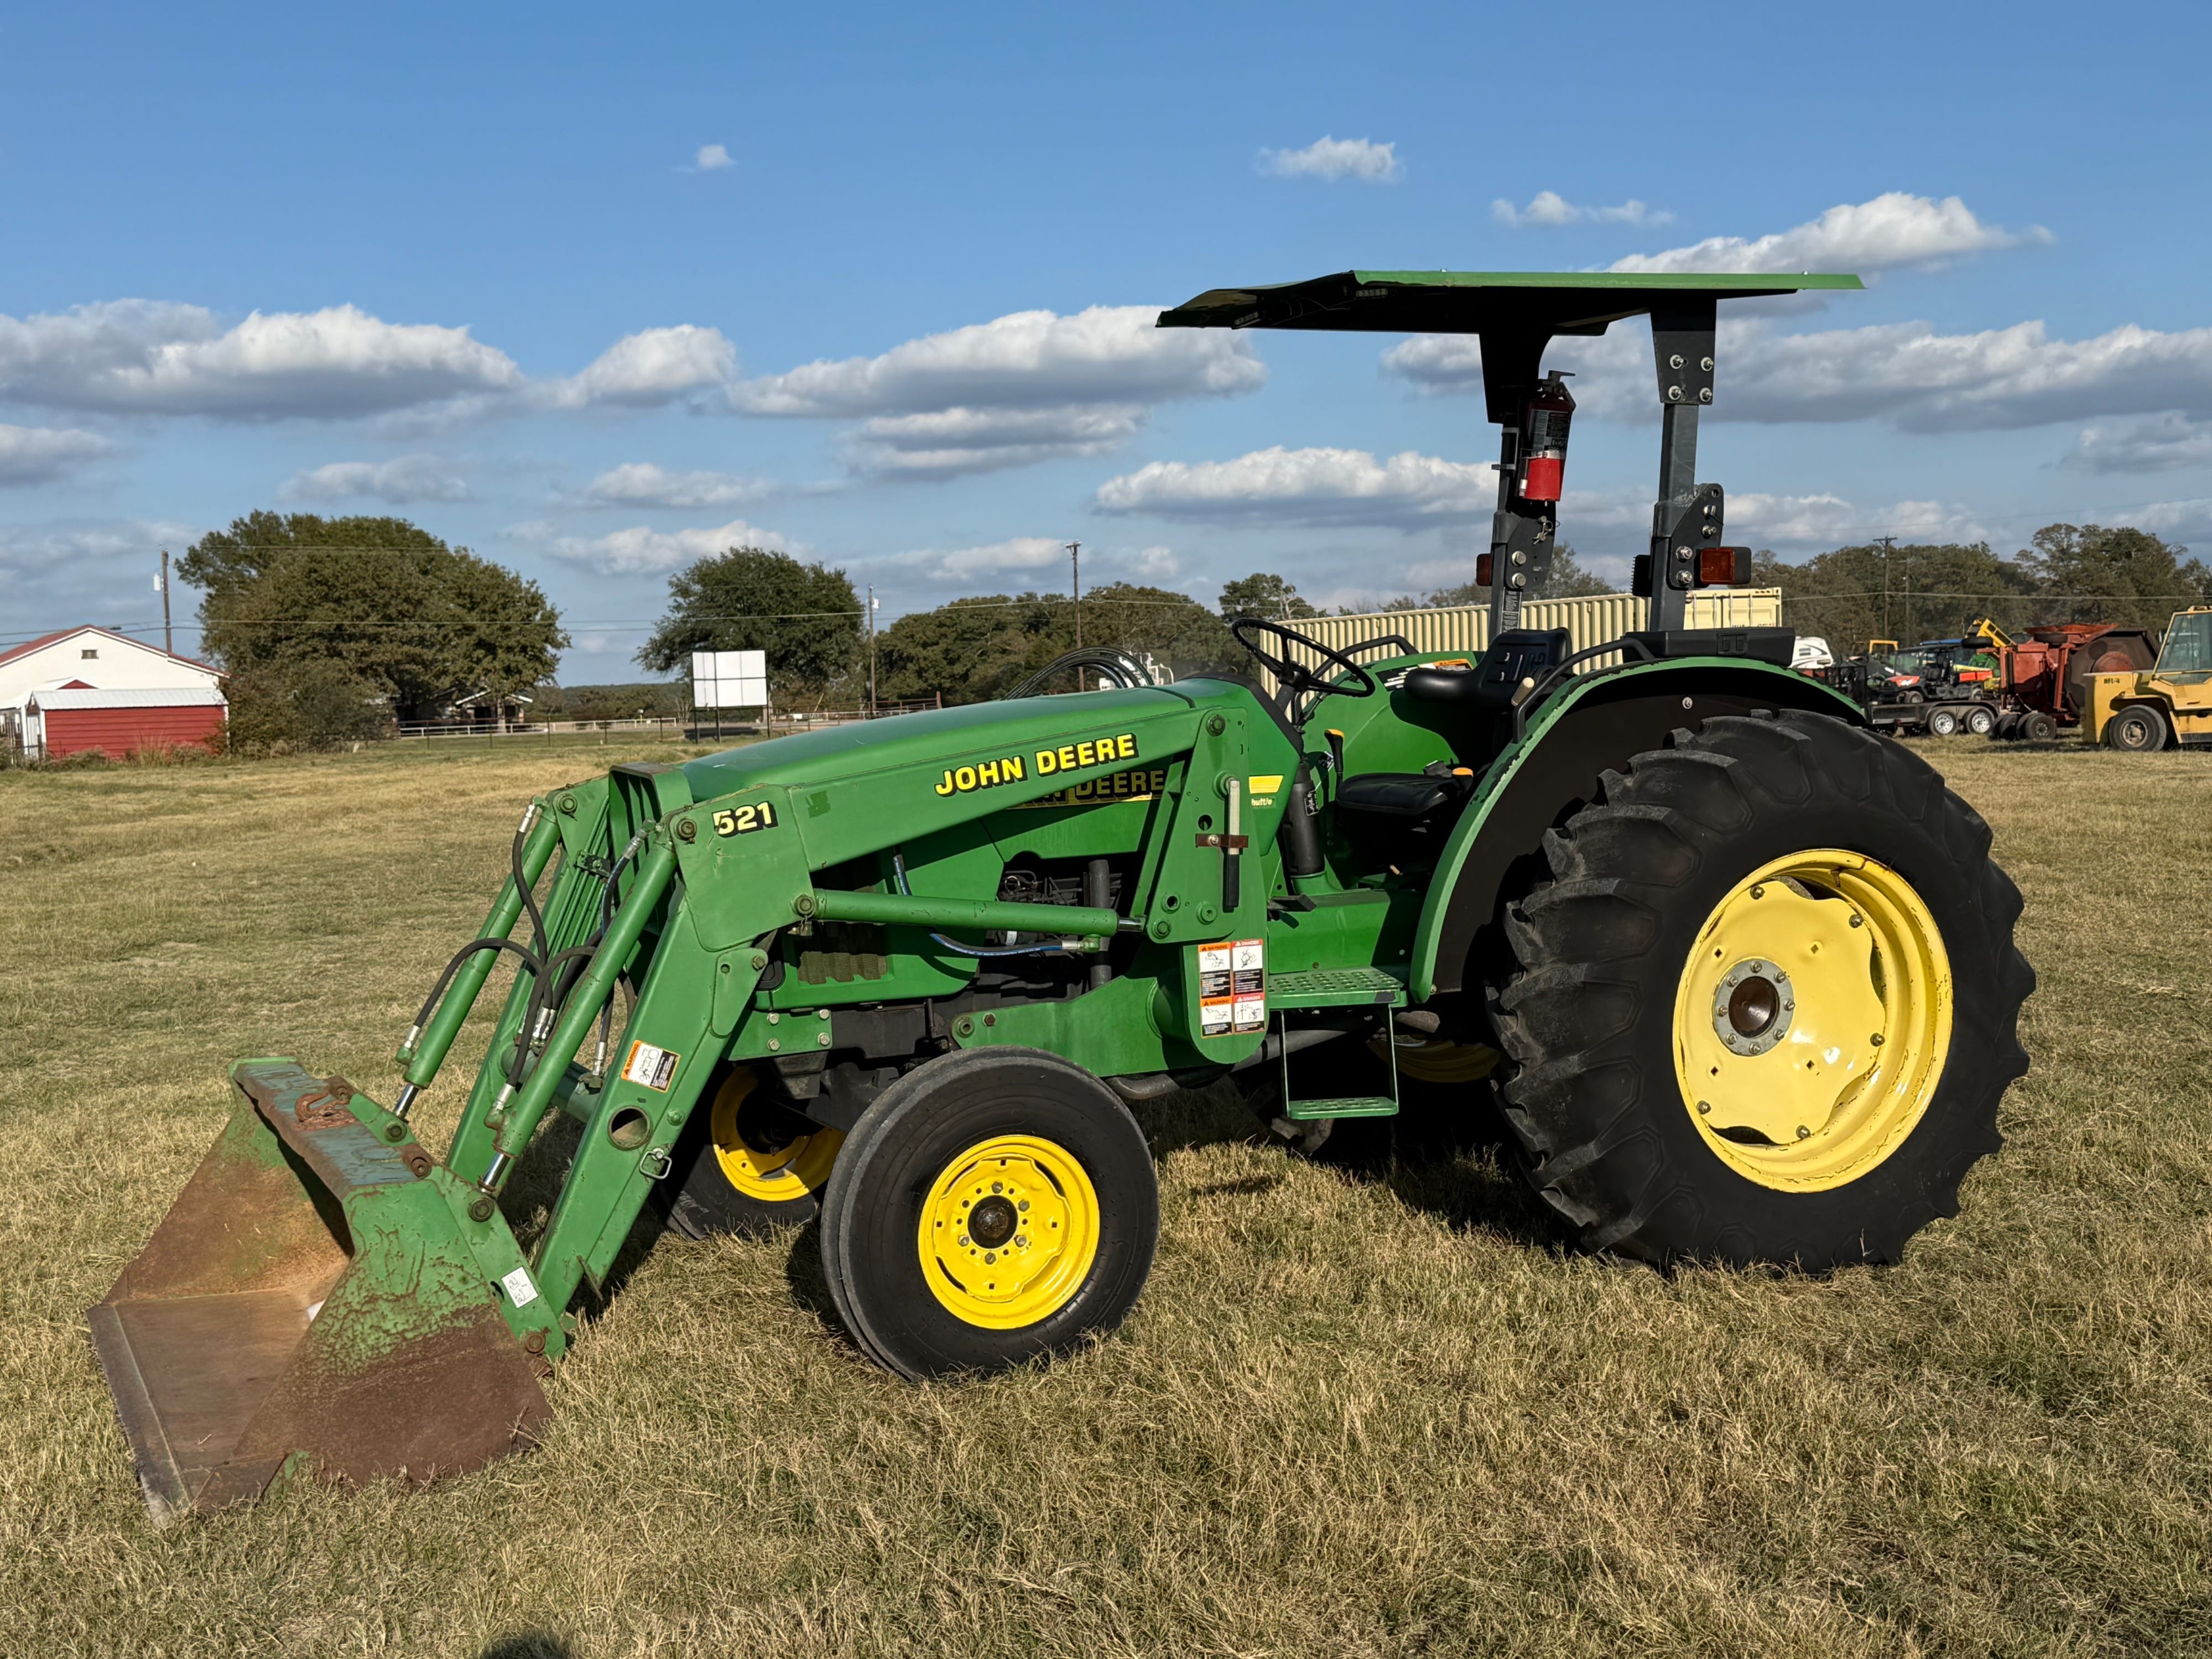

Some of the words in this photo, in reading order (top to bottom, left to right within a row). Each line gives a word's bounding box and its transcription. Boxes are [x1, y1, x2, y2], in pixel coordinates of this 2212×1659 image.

[935, 755, 1026, 796] JOHN
[1035, 733, 1137, 775] DEERE
[1076, 770, 1164, 796] DEERE
[712, 801, 773, 835] 521
